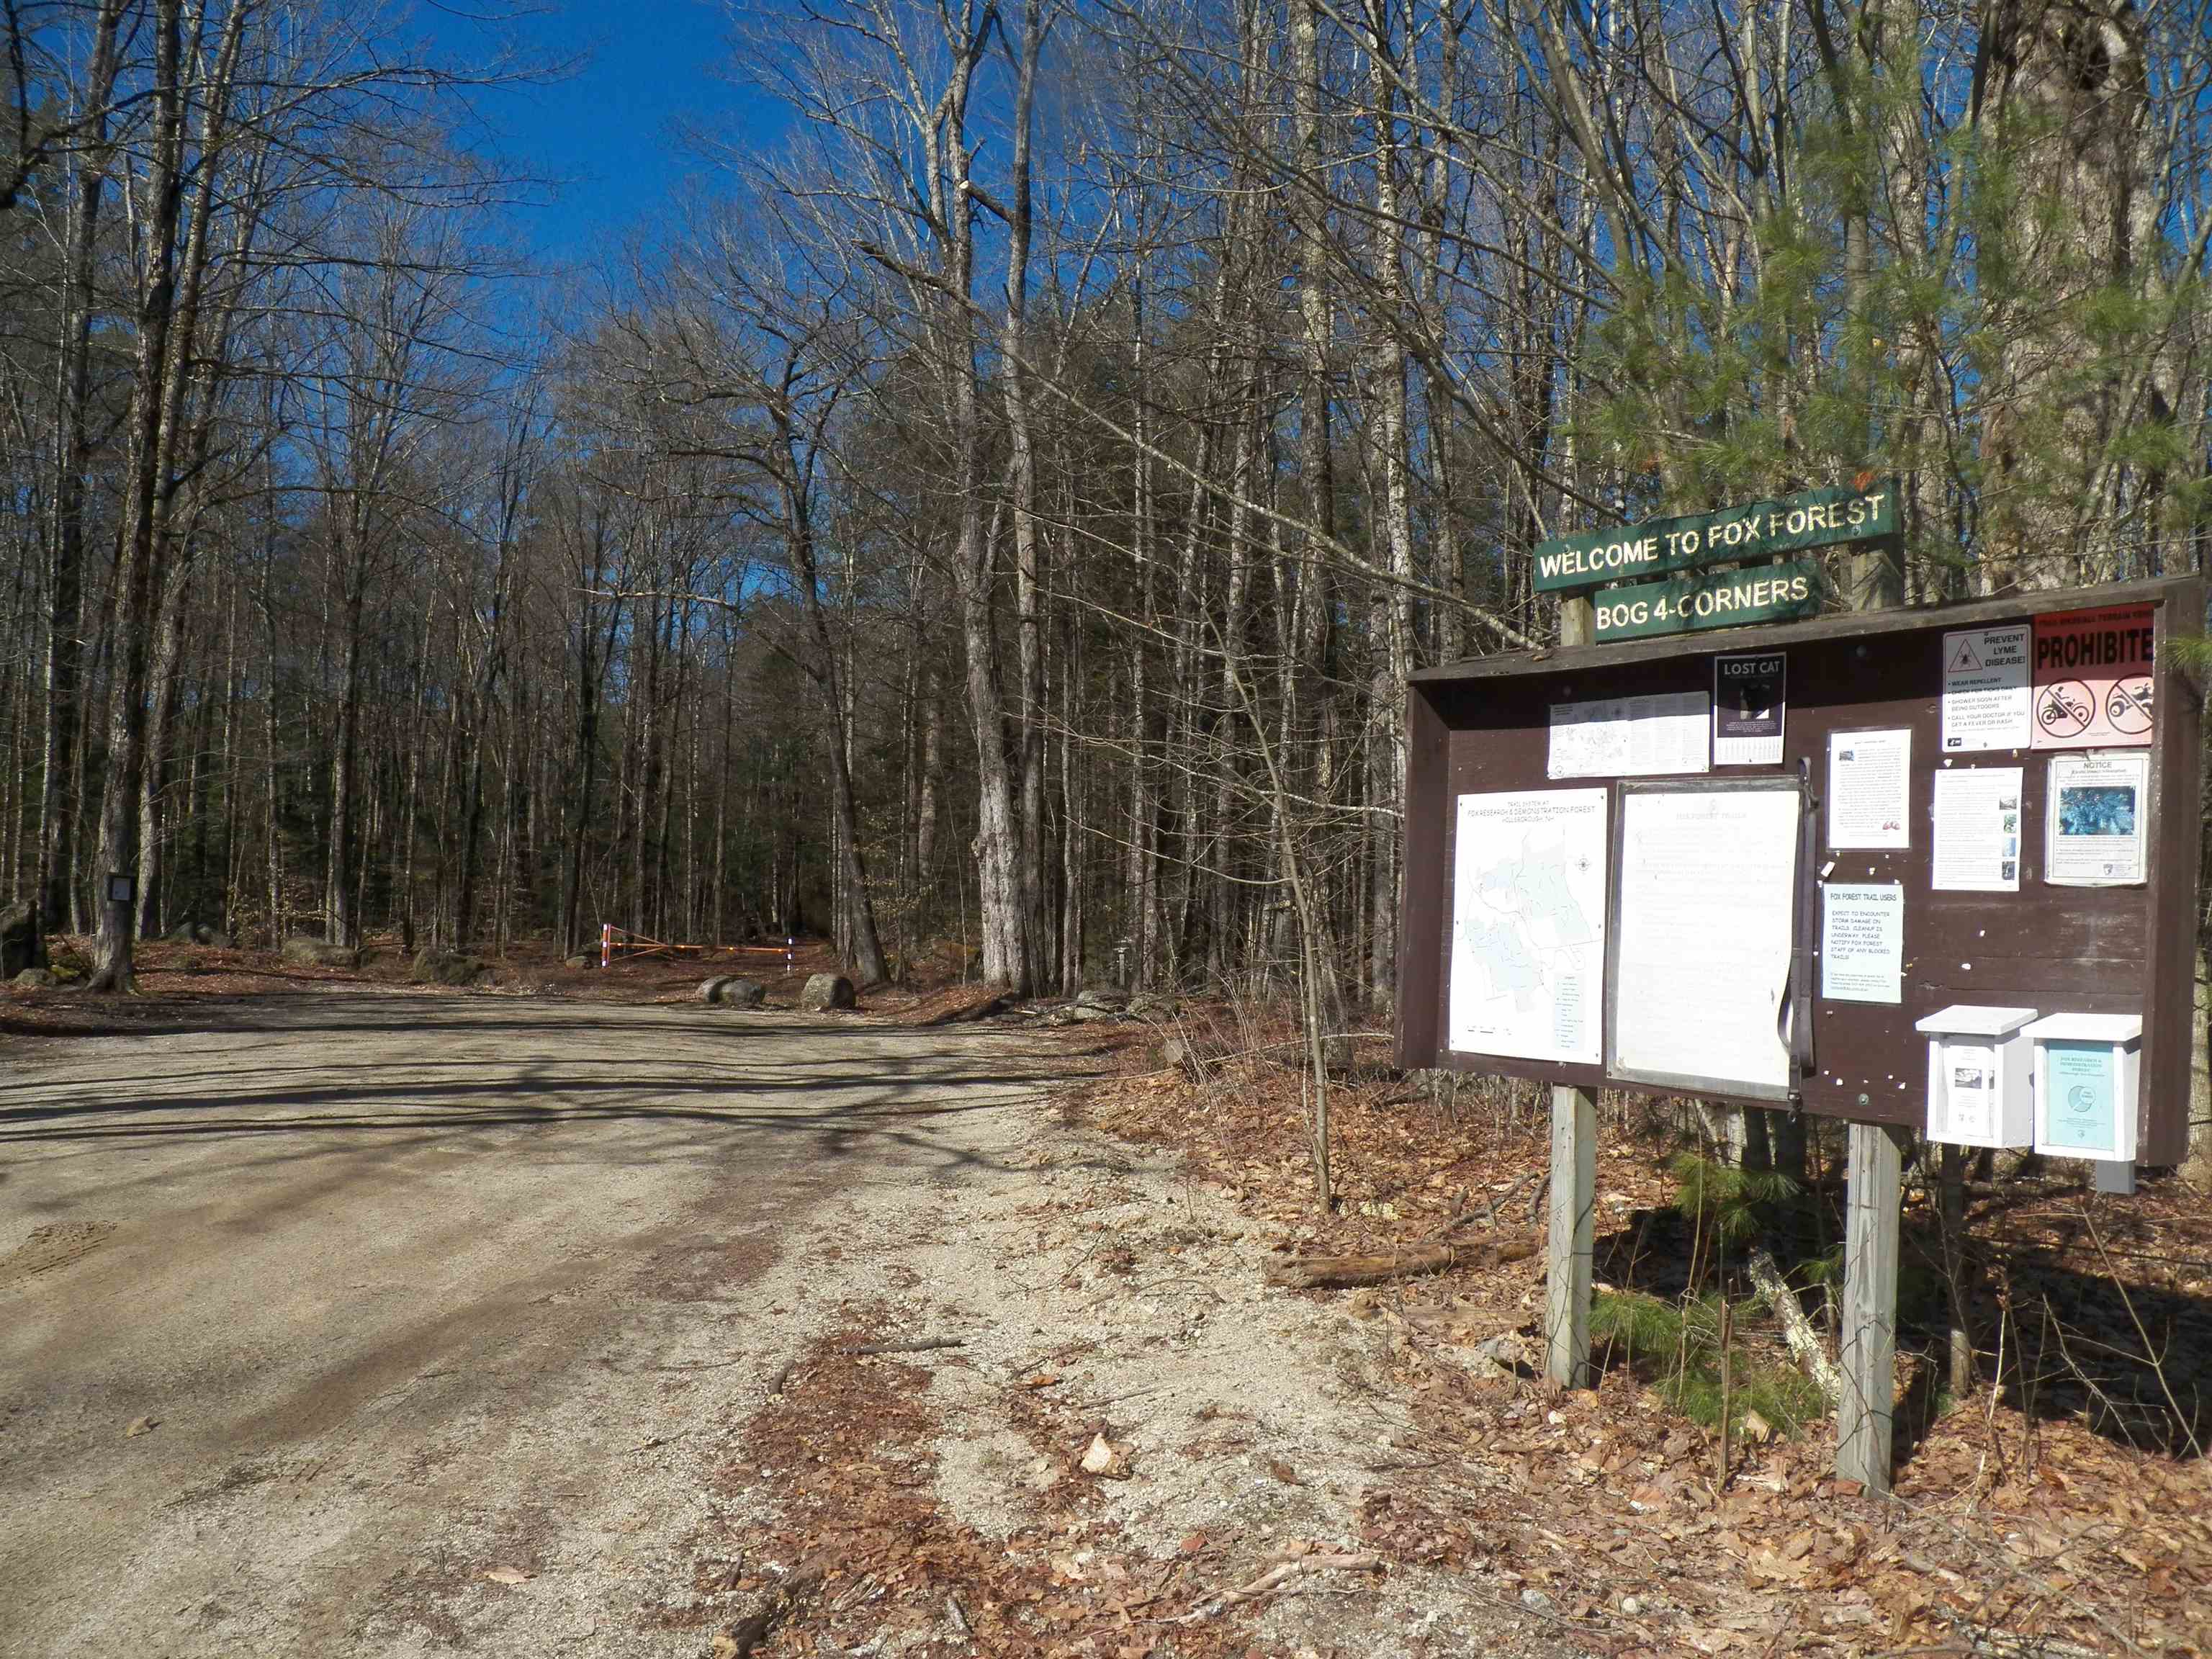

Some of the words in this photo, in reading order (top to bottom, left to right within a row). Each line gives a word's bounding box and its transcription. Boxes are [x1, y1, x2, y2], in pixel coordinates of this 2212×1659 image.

[1539, 538, 1658, 578] WELCOME
[1665, 530, 1699, 556] TO
[1709, 513, 1761, 549] FOX
[1770, 495, 1884, 537] FOREST
[1596, 601, 1647, 630] BOG
[1653, 576, 1809, 621] 4-CORNERS
[1984, 634, 2025, 645] PREVENT
[1993, 645, 2017, 655] LYME
[1725, 662, 1757, 675] LOST
[1759, 660, 1781, 673] CAT
[1480, 808, 1508, 817] RESEARCH
[1514, 806, 1569, 816] DEMONSTRATION
